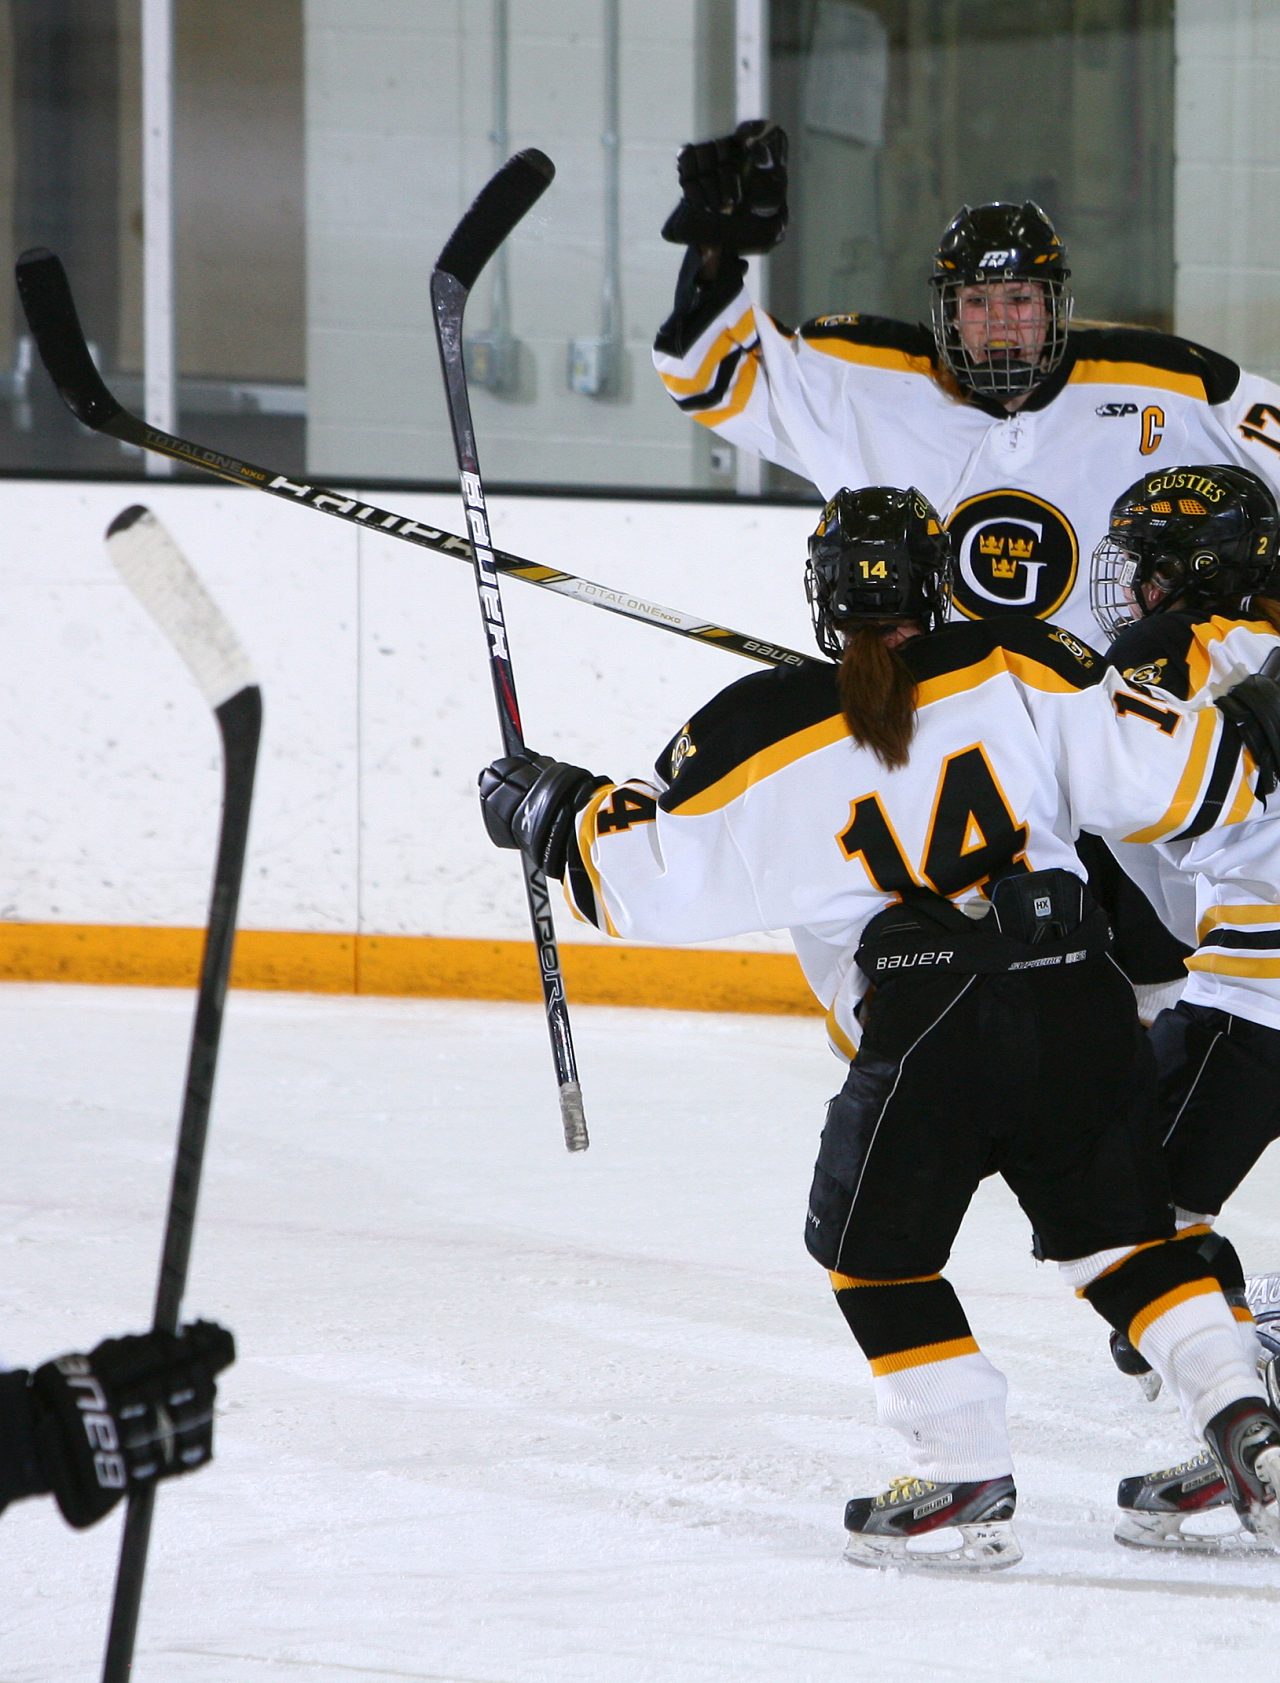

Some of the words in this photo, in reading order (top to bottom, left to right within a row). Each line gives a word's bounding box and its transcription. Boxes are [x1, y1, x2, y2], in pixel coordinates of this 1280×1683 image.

[1139, 405, 1165, 456] C
[1147, 473, 1227, 502] GUSTIES
[959, 516, 1048, 606] G
[1257, 537, 1268, 555] 2
[858, 560, 888, 579] 14
[834, 740, 1035, 906] 14
[529, 866, 566, 1017] VAPOR
[876, 951, 954, 970] BAUER
